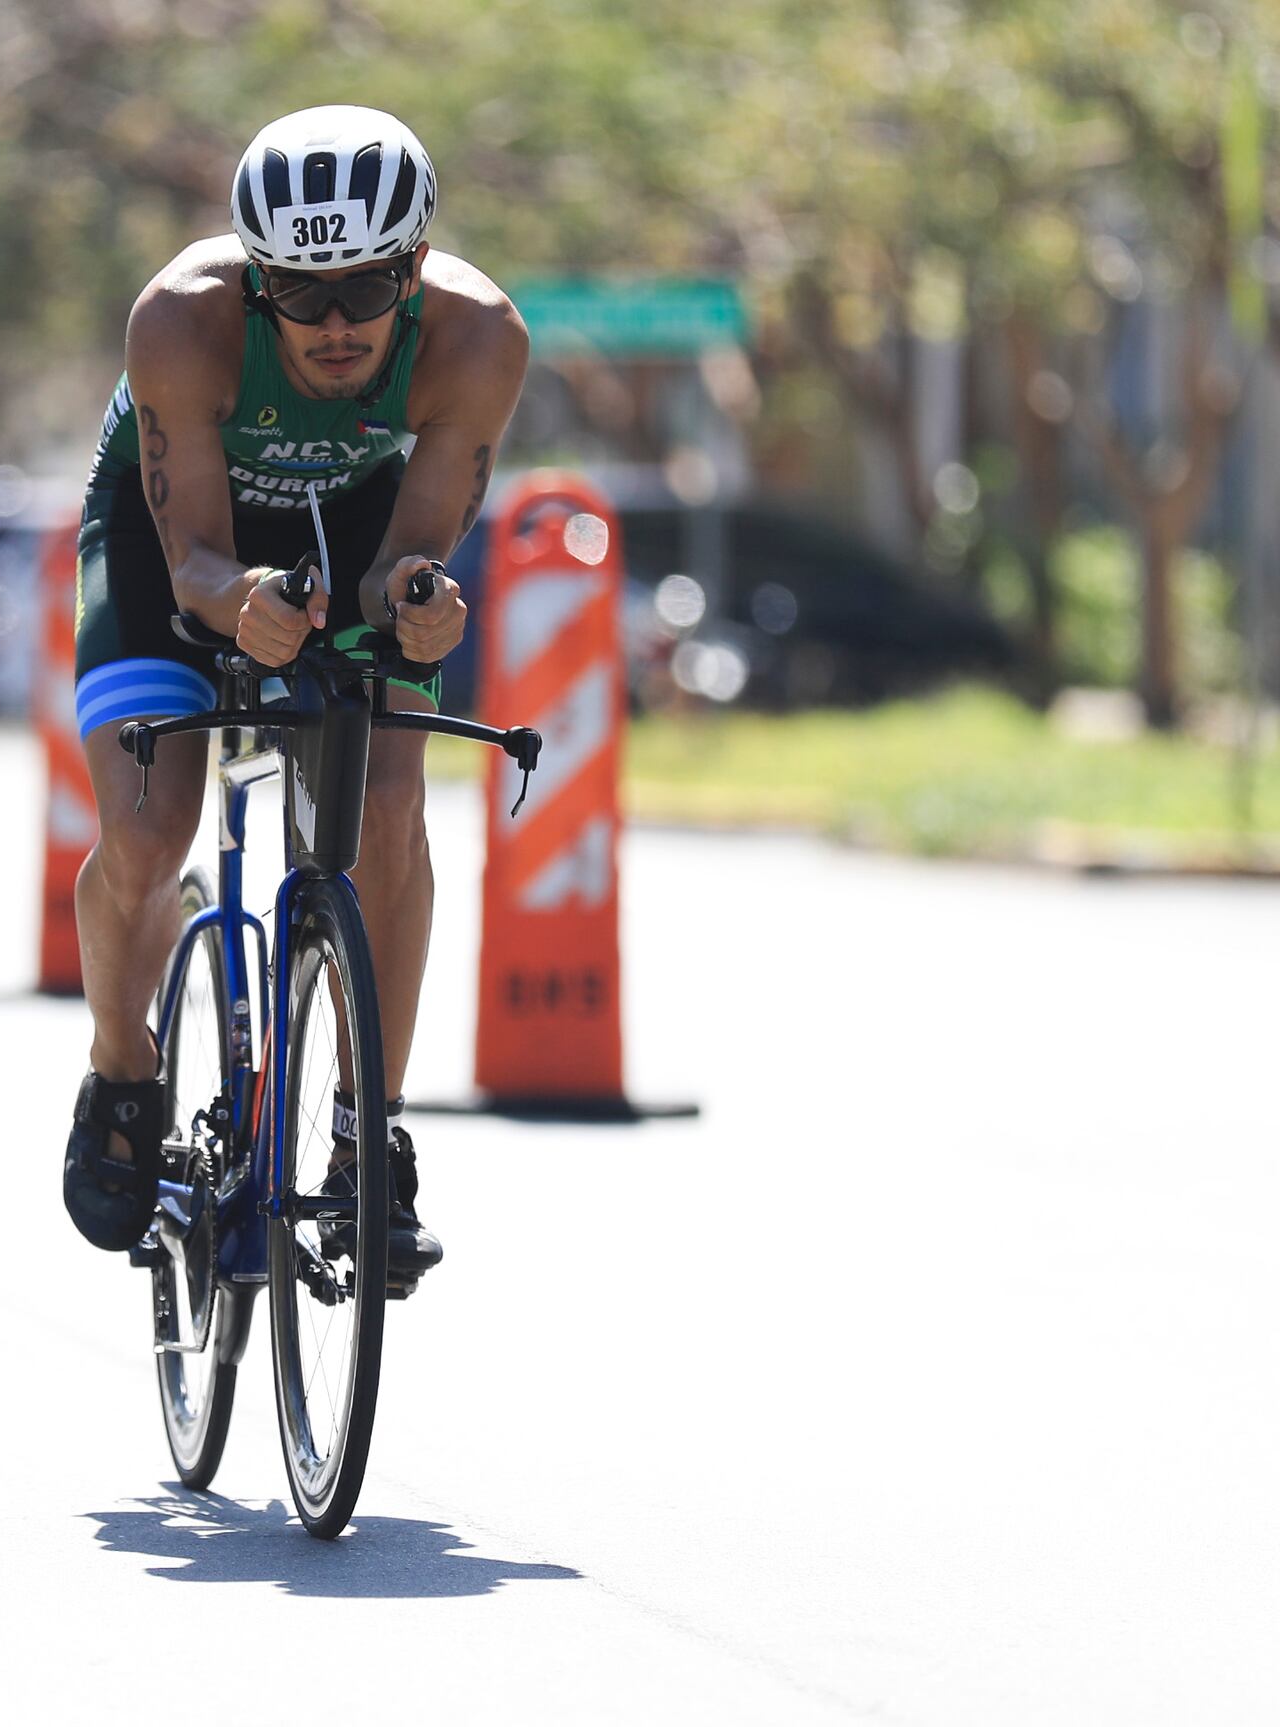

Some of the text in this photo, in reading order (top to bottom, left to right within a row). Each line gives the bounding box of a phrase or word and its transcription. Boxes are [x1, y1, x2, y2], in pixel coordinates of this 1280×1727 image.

[292, 213, 348, 248] 302
[260, 440, 370, 461] NCY
[228, 465, 353, 493] DURAN
